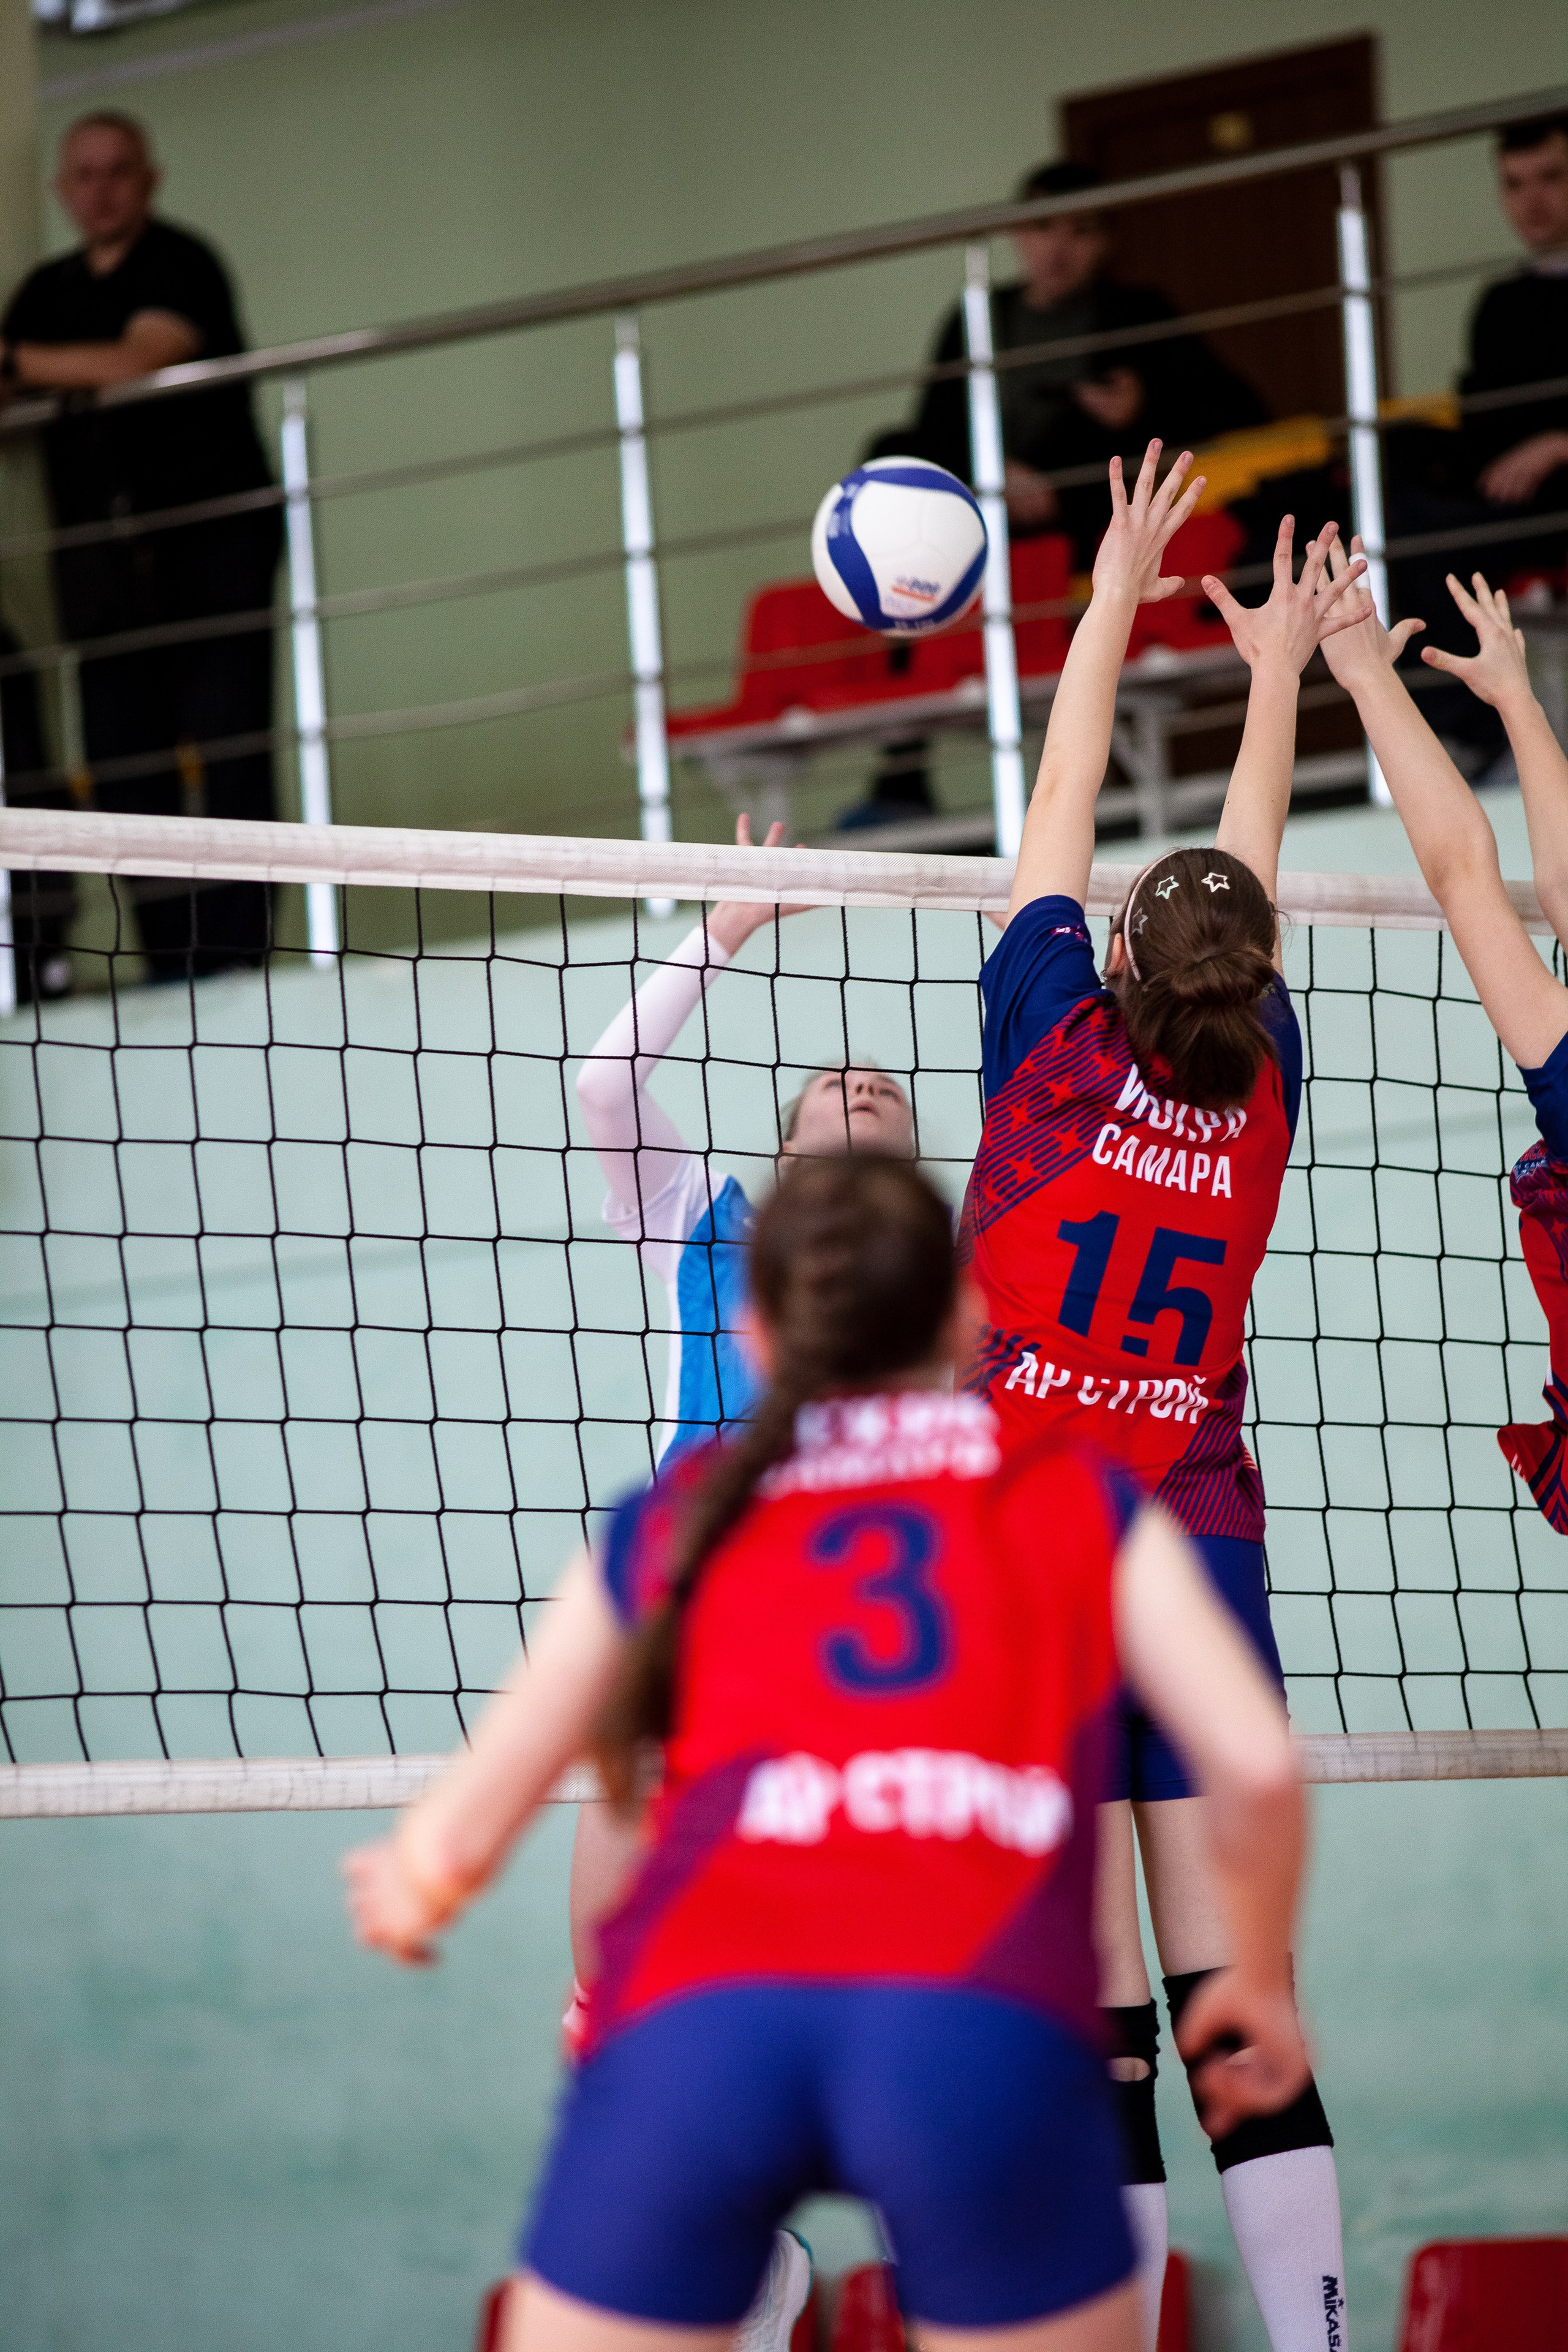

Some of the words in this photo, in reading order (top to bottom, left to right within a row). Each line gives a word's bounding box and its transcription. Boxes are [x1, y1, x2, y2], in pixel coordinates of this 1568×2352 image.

[1092, 1123, 1232, 1199] САМАРА
[1057, 1210, 1227, 1366] 15
[808, 1503, 952, 1698] 3
